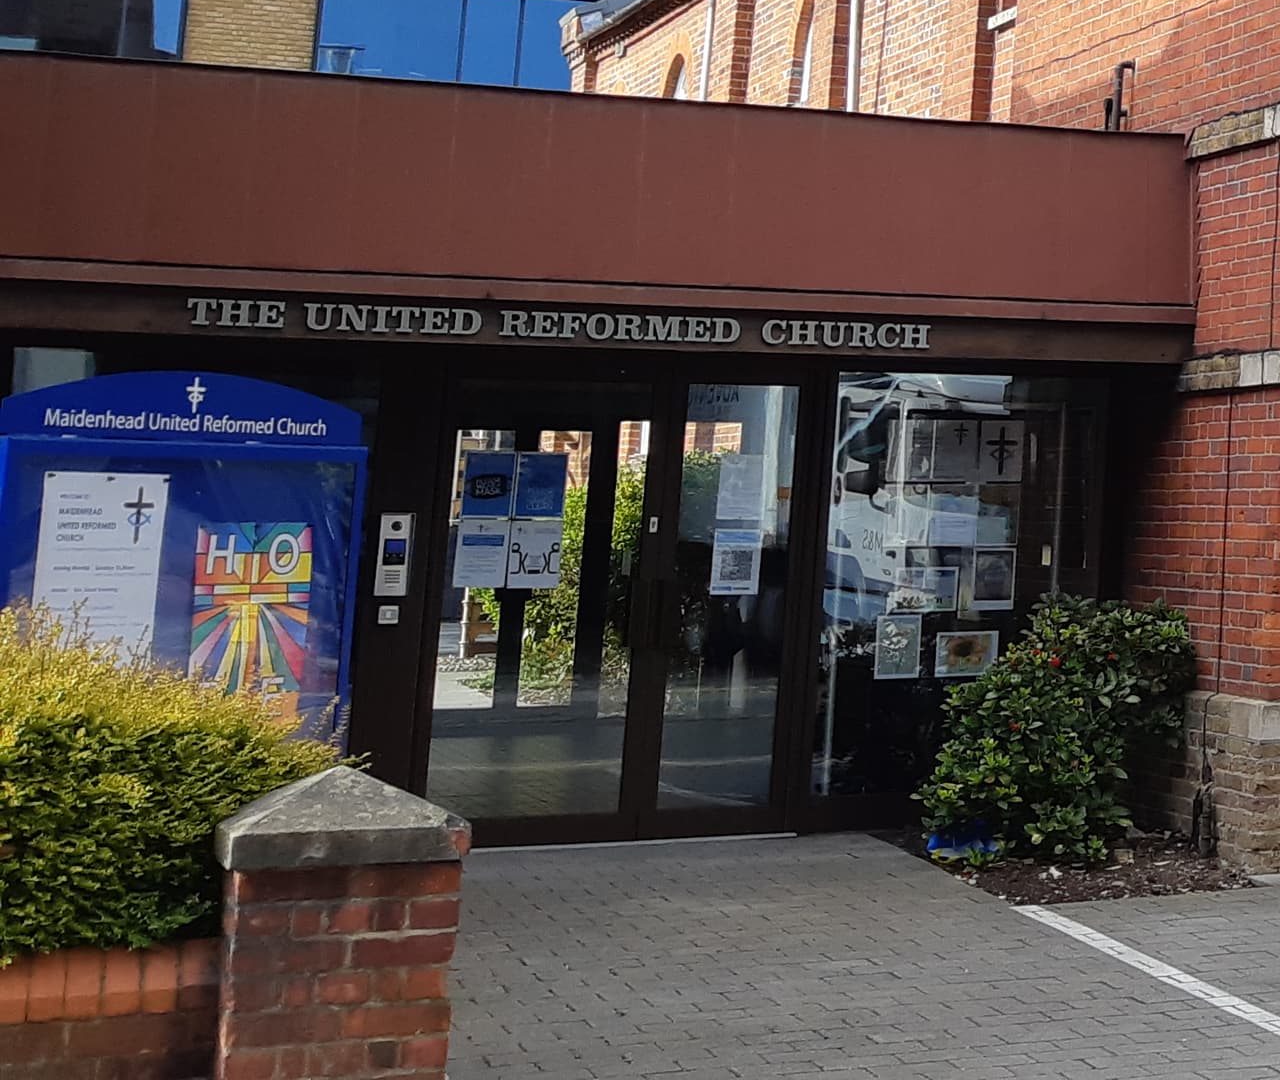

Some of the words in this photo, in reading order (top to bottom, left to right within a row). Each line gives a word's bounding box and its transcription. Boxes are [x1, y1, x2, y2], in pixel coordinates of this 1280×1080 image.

[187, 297, 287, 329] THE
[303, 302, 483, 336] UNITED
[499, 309, 742, 344] REFORMED
[761, 319, 932, 349] CHURCH
[44, 408, 146, 430] Maidenhead
[149, 413, 200, 432] United
[203, 415, 274, 434] Reformed
[277, 418, 327, 437] Church
